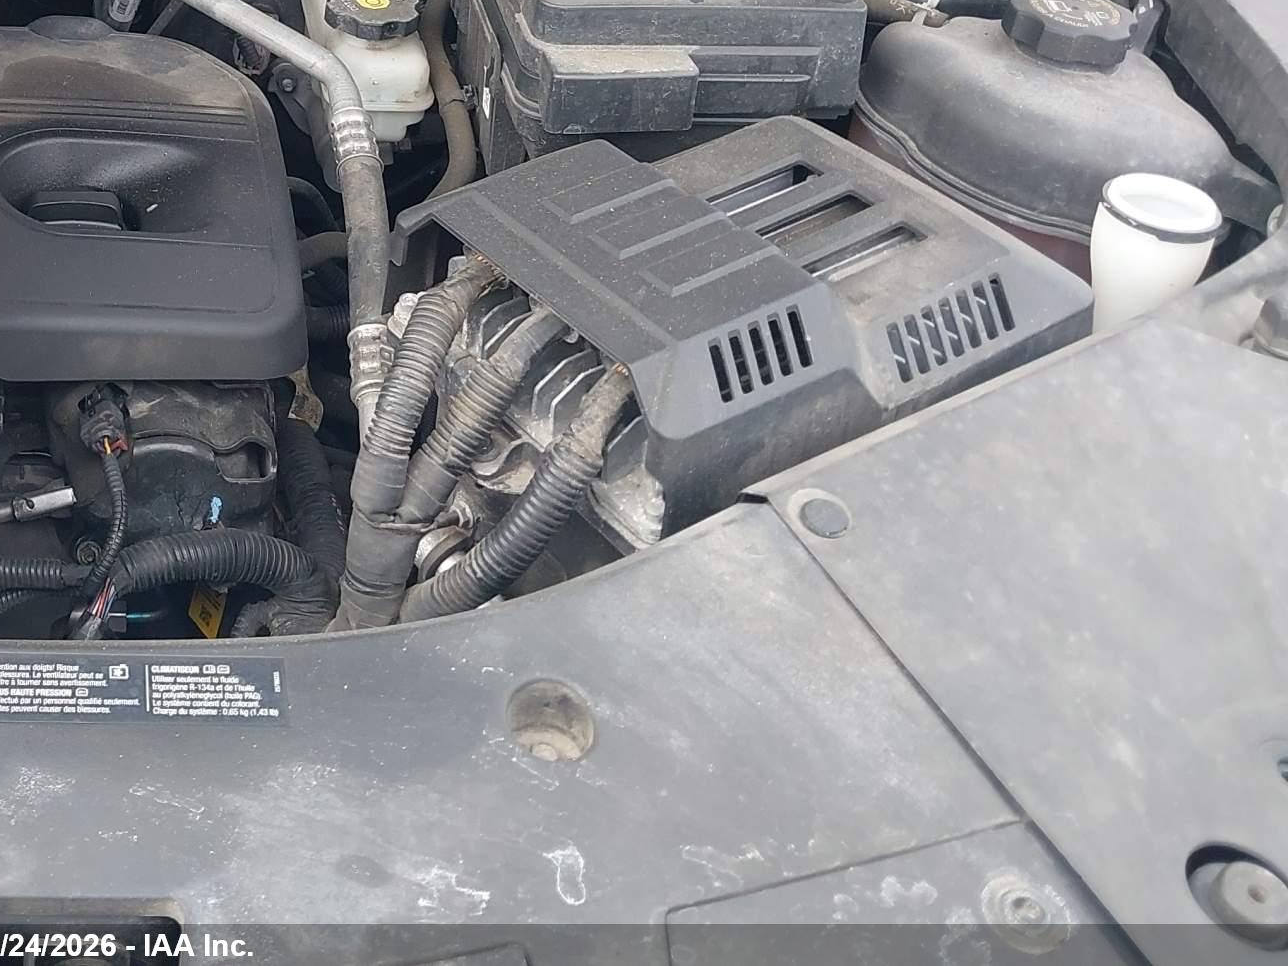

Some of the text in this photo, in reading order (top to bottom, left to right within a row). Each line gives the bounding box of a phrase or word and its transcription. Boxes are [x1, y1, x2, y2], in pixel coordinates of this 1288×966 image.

[78, 672, 94, 680] peut
[16, 679, 41, 687] tourner
[189, 683, 215, 691] R-134a
[10, 688, 34, 696] HAUTE
[35, 688, 72, 696] PRESSION
[43, 698, 76, 706] personnel
[77, 698, 102, 706] qualifié
[10, 705, 38, 713] peuvent
[152, 707, 178, 716] Charge
[239, 709, 249, 717] kg
